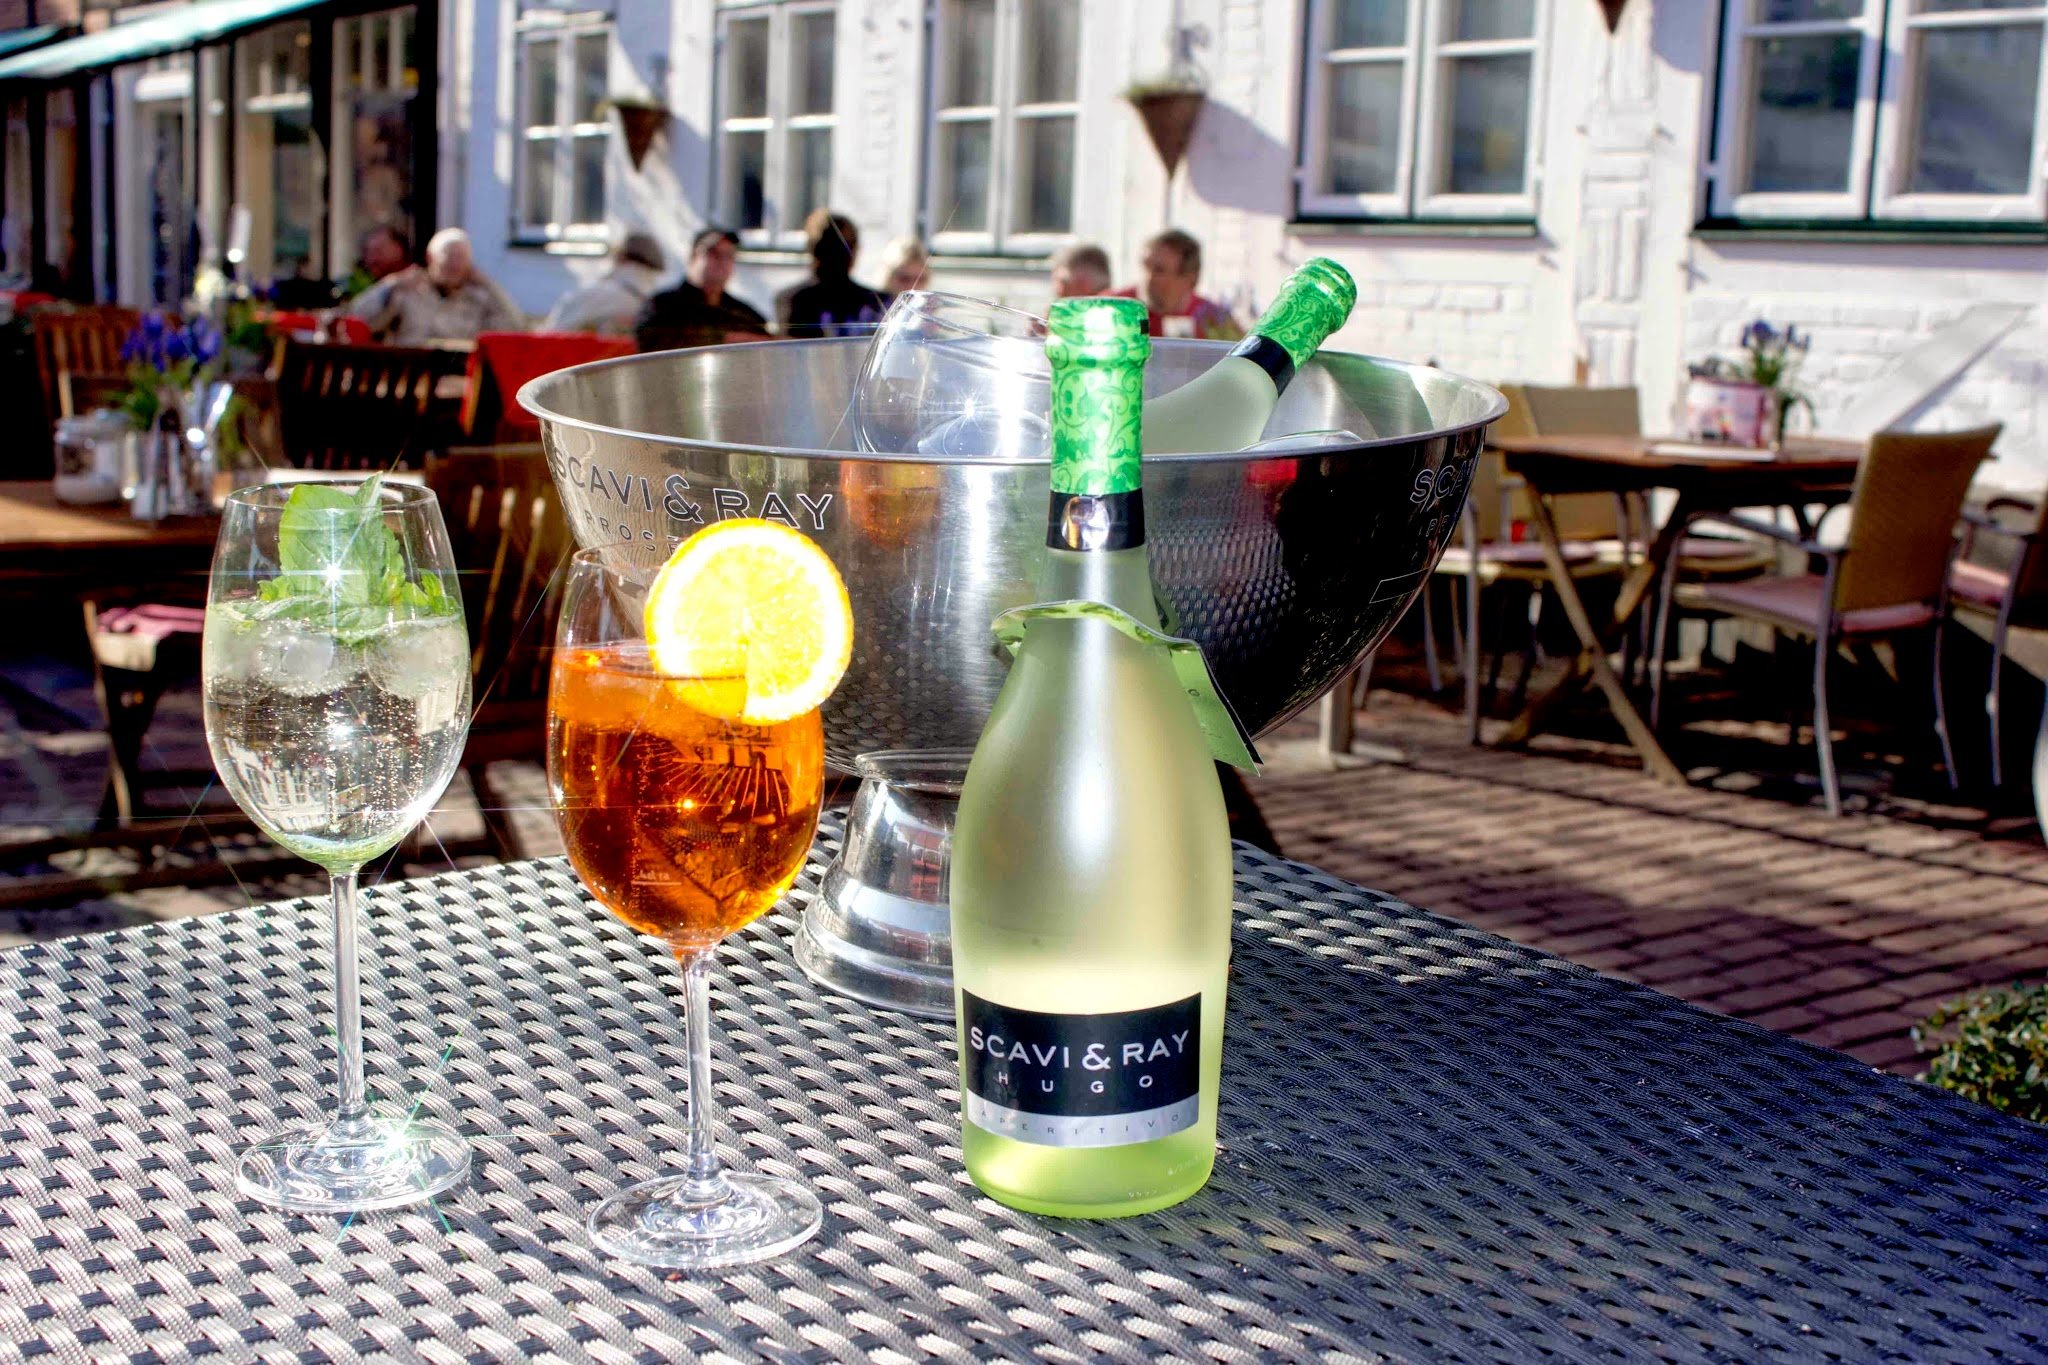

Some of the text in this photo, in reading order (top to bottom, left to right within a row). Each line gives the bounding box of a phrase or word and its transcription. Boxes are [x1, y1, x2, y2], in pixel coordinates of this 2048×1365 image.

[551, 446, 834, 530] SCAVI & RAY
[970, 1026, 1189, 1071] SCAVI & RAY
[998, 1071, 1153, 1093] HUGO
[981, 1111, 1180, 1136] APERITIVO
